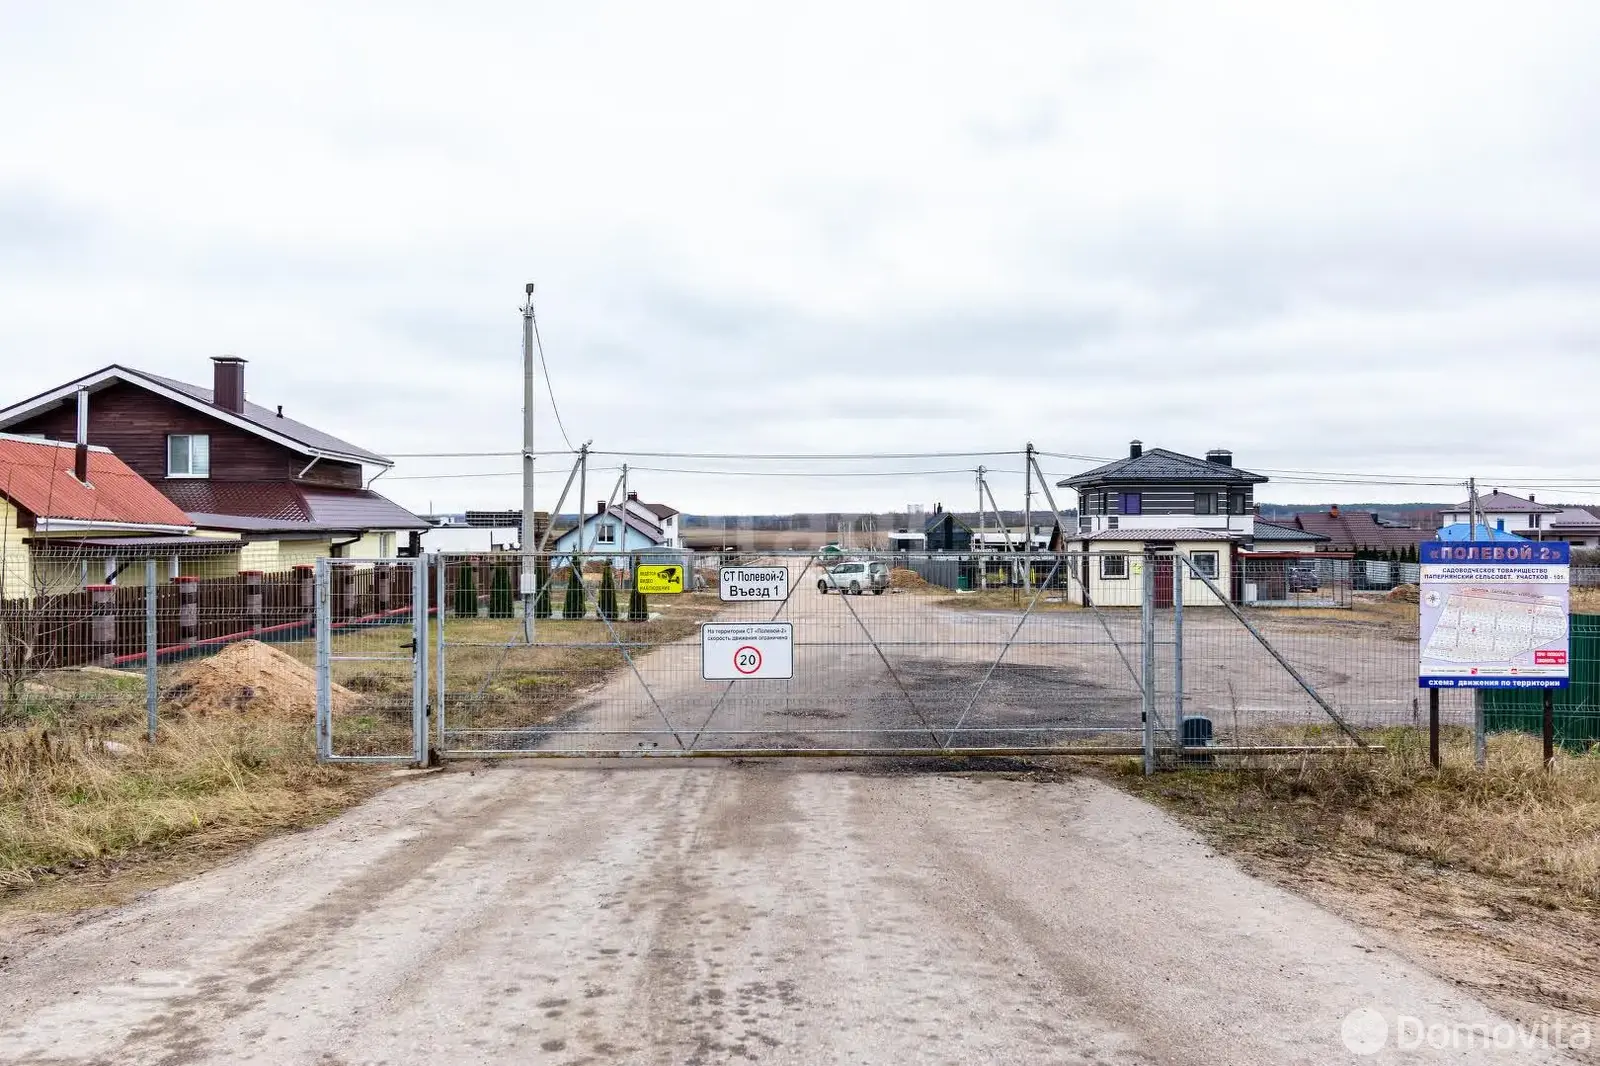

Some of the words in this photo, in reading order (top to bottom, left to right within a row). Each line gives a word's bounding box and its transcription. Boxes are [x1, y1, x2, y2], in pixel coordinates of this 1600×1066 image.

[723, 570, 736, 582] СТ
[737, 570, 784, 582] Полевой-2
[729, 586, 770, 598] Въезд
[773, 586, 779, 596] 1
[740, 655, 756, 666] 20
[1512, 680, 1561, 688] территории
